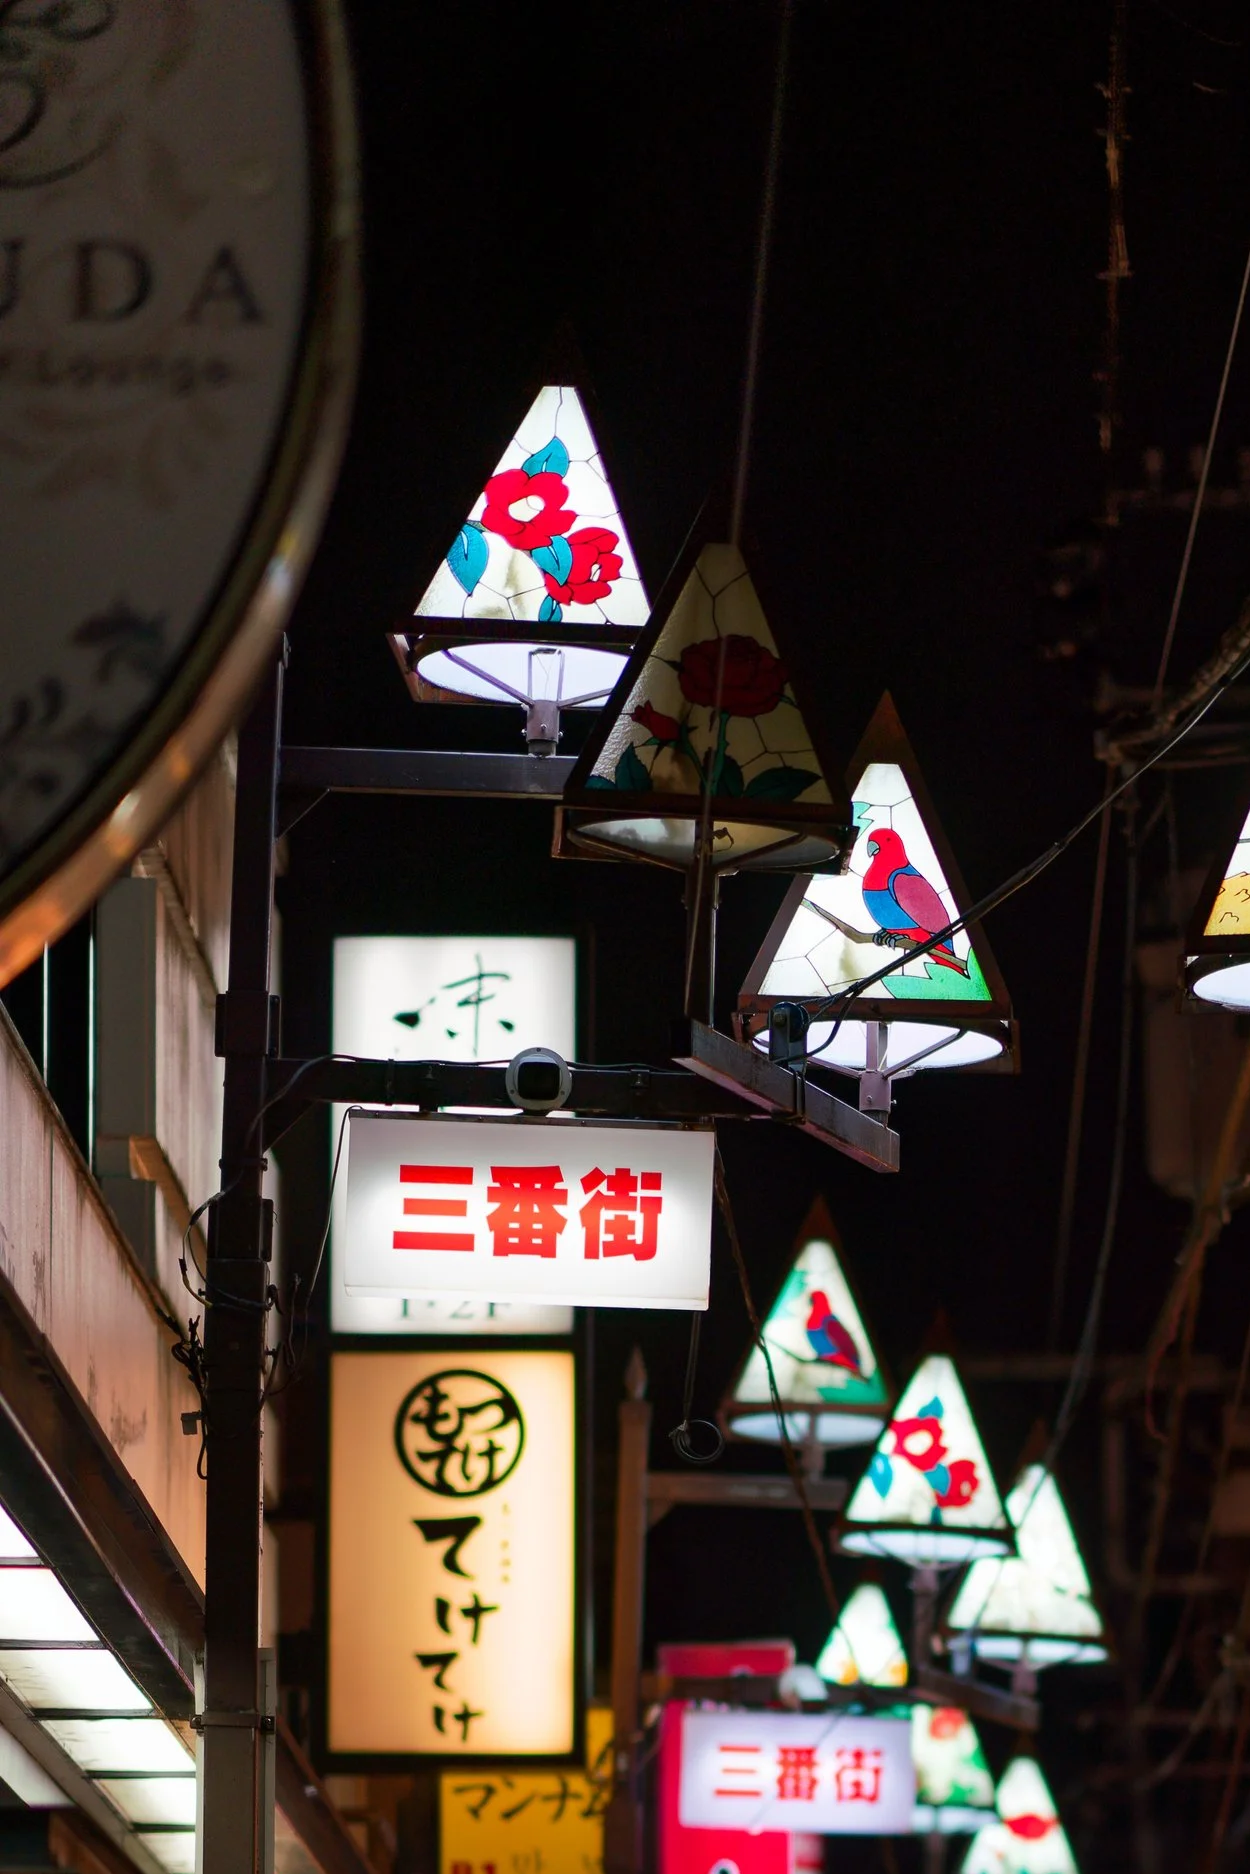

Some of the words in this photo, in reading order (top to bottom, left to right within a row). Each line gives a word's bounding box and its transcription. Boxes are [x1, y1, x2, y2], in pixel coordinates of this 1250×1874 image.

[392, 1164, 664, 1261] 三番街
[411, 1514, 500, 1743] てけてけ
[713, 1744, 884, 1804] 三番街
